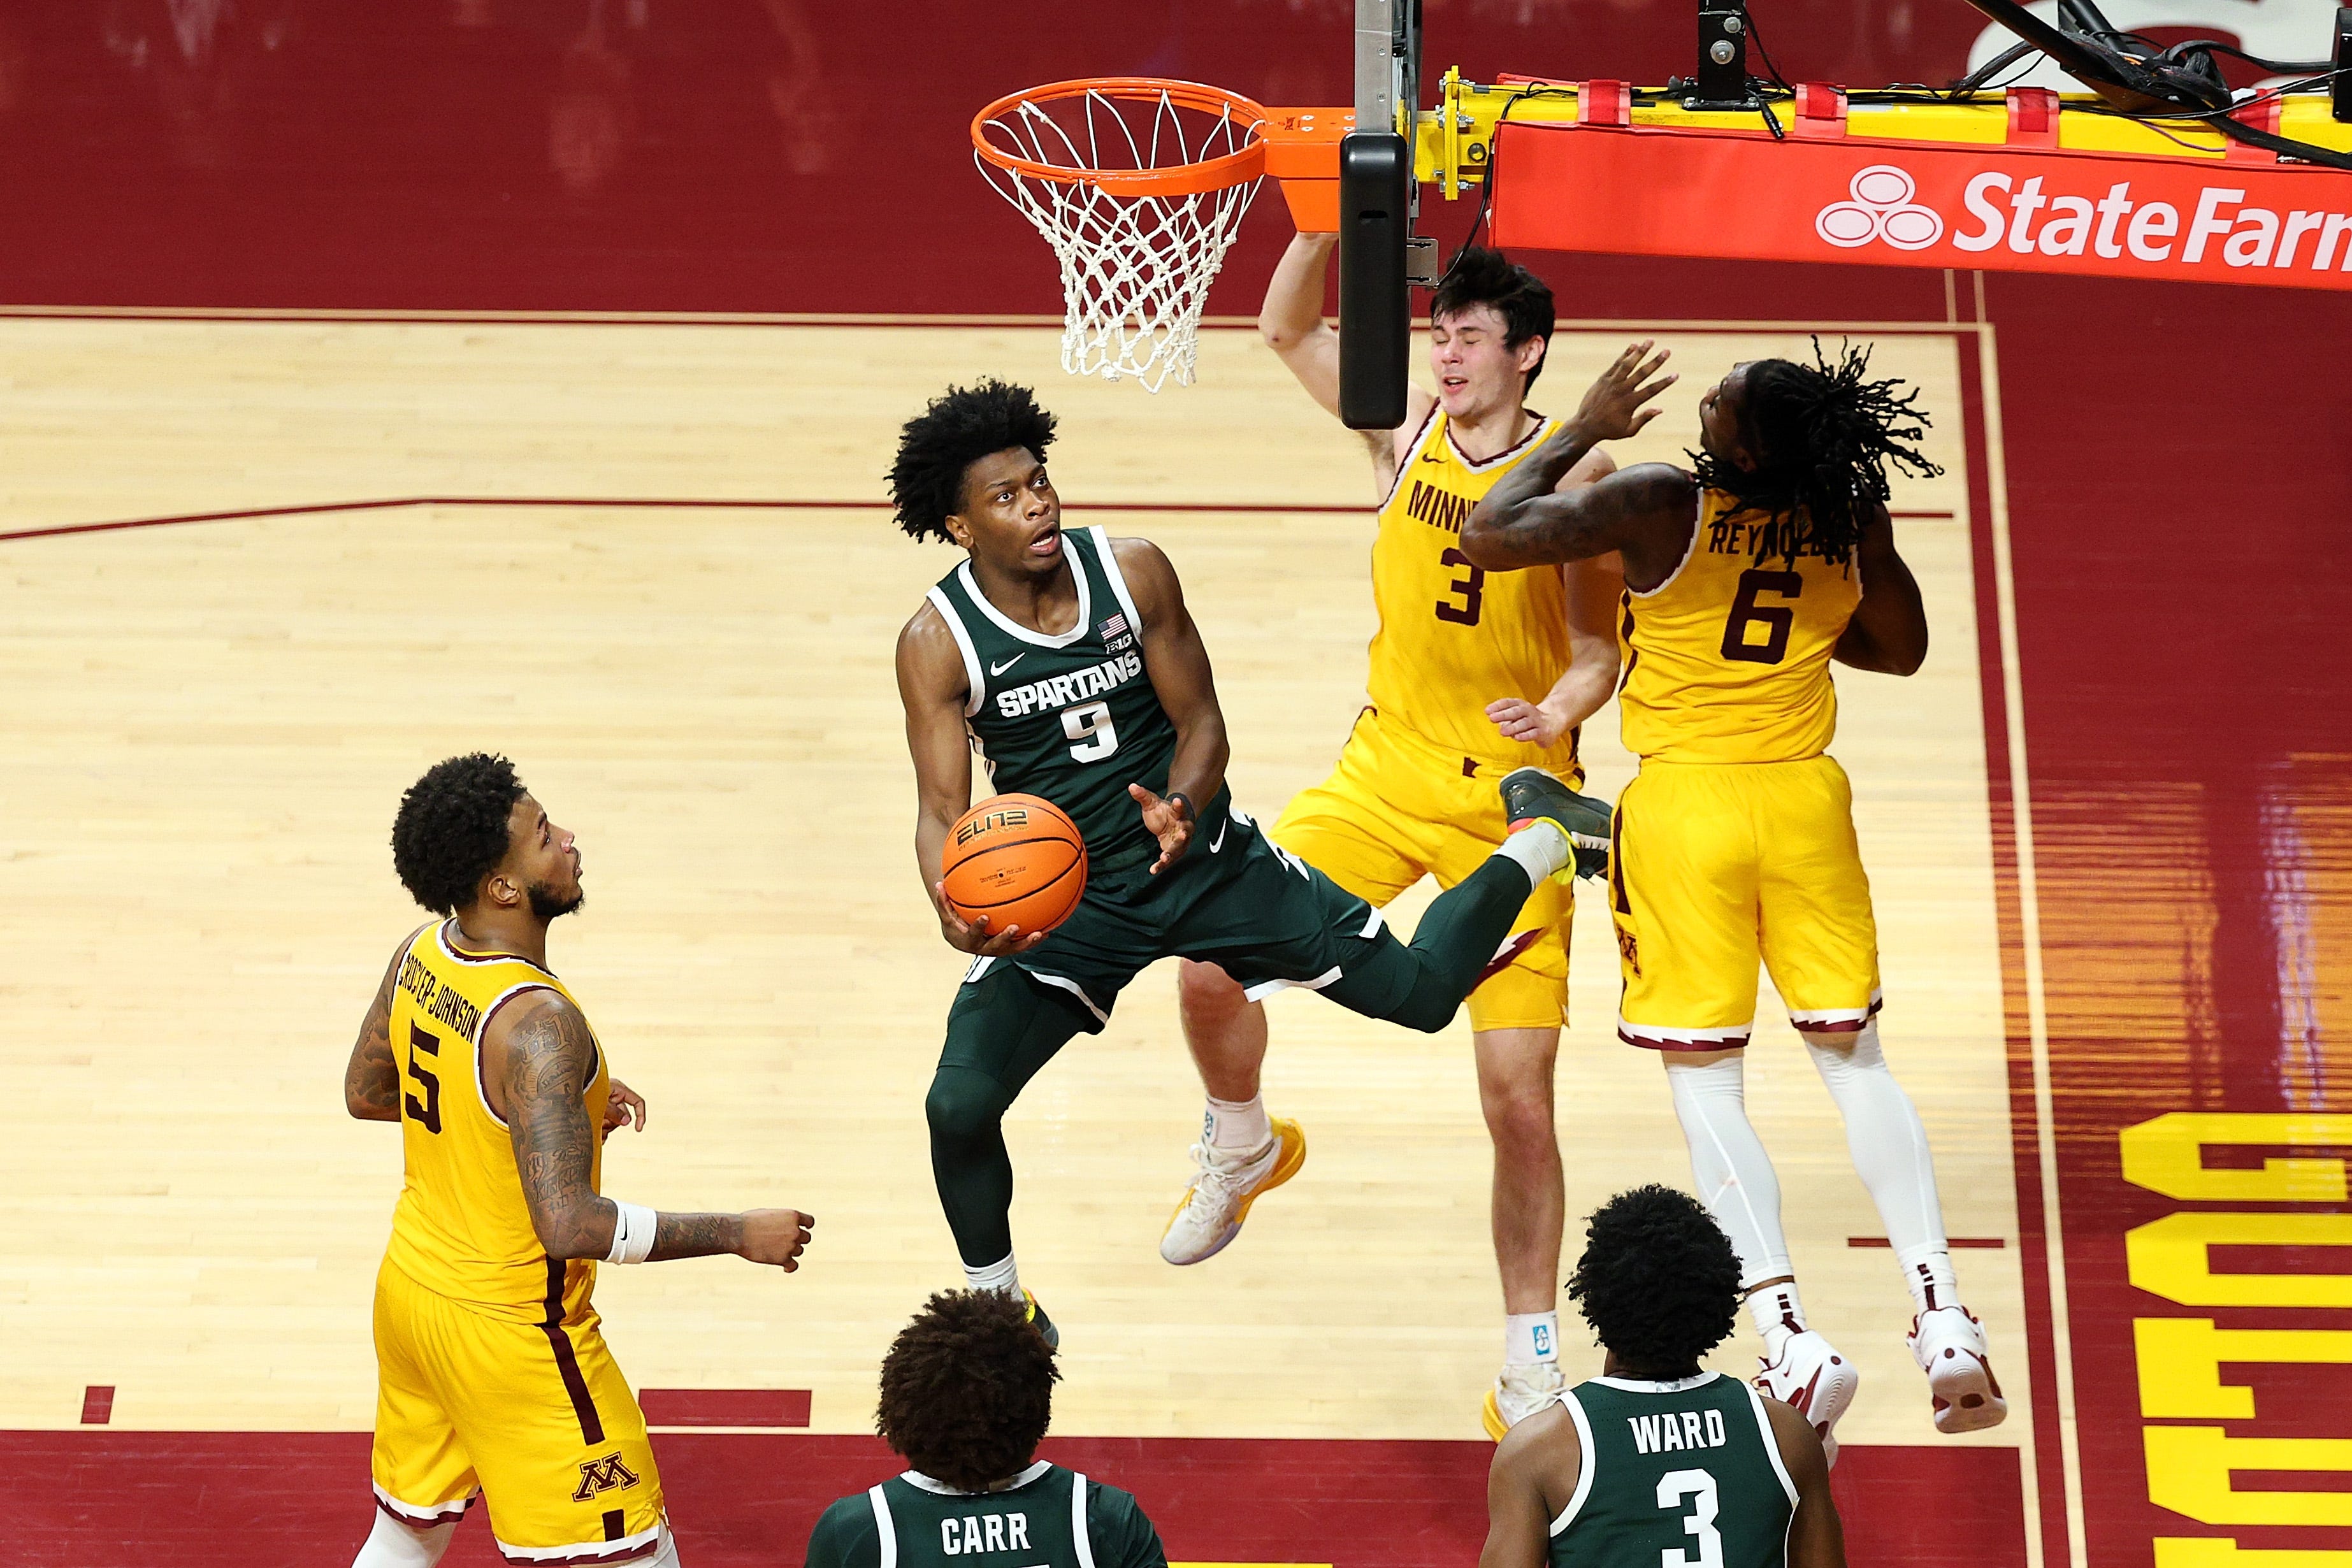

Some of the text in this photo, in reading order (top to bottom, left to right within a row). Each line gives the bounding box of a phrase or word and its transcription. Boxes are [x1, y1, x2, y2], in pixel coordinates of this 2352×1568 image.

[1407, 480, 1480, 534] MINN
[1436, 547, 1485, 627] 3
[1721, 568, 1803, 665] 6
[996, 649, 1142, 718] SPARTANS
[1060, 700, 1119, 764] 9
[956, 809, 1028, 847] ELITE
[405, 1017, 442, 1135] 5
[1627, 1409, 1727, 1455] WARD
[941, 1512, 1032, 1556] CARR
[1656, 1468, 1725, 1568] 3
